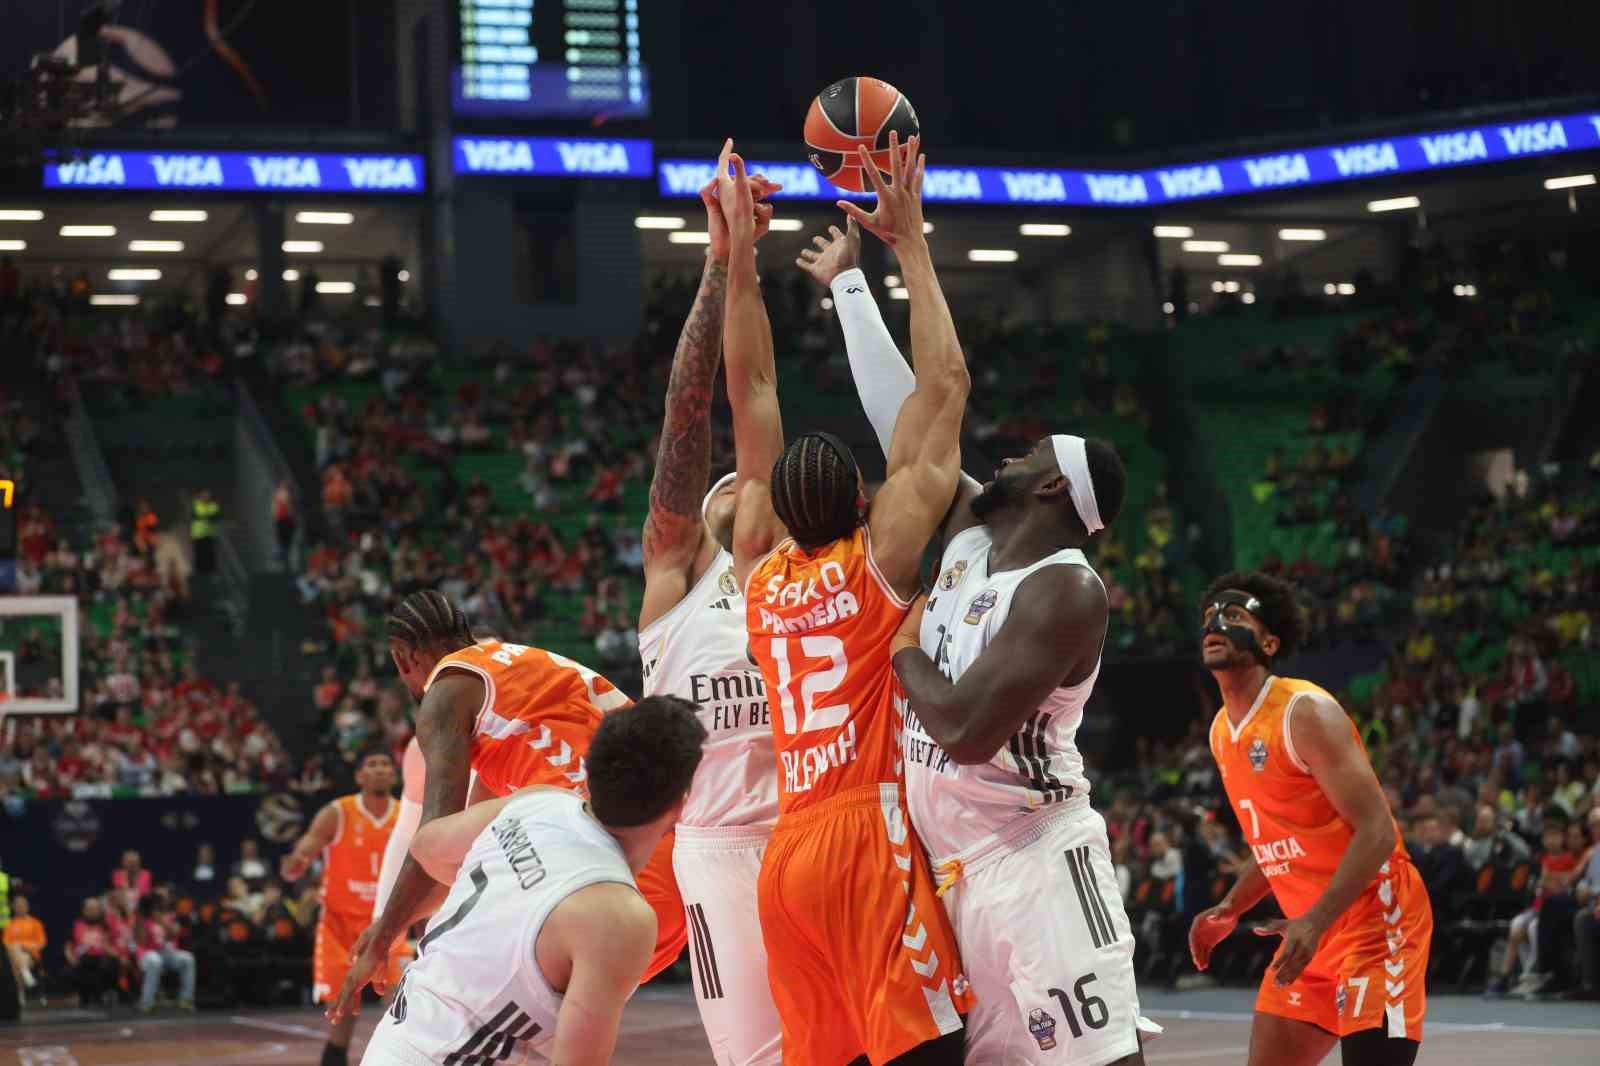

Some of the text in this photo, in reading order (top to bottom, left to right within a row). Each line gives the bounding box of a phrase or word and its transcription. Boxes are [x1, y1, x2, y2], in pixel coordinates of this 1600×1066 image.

[57, 154, 417, 189] VISA VISA VISA VISA
[460, 139, 630, 173] VISA VISA
[1001, 171, 1066, 201] VISA
[1083, 173, 1148, 203] VISA
[1157, 164, 1223, 198] VISA
[1243, 153, 1310, 188] VISA
[1331, 141, 1399, 177] VISA
[1420, 129, 1488, 165] VISA
[1501, 120, 1568, 155] VISA
[765, 561, 847, 607] SAKO
[690, 670, 767, 703] Emir
[770, 635, 850, 736] 12
[714, 701, 770, 730] FLY BE
[1239, 799, 1260, 839] 7
[418, 861, 489, 957] 7
[1047, 972, 1110, 1039] 16
[1348, 975, 1370, 1018] 7
